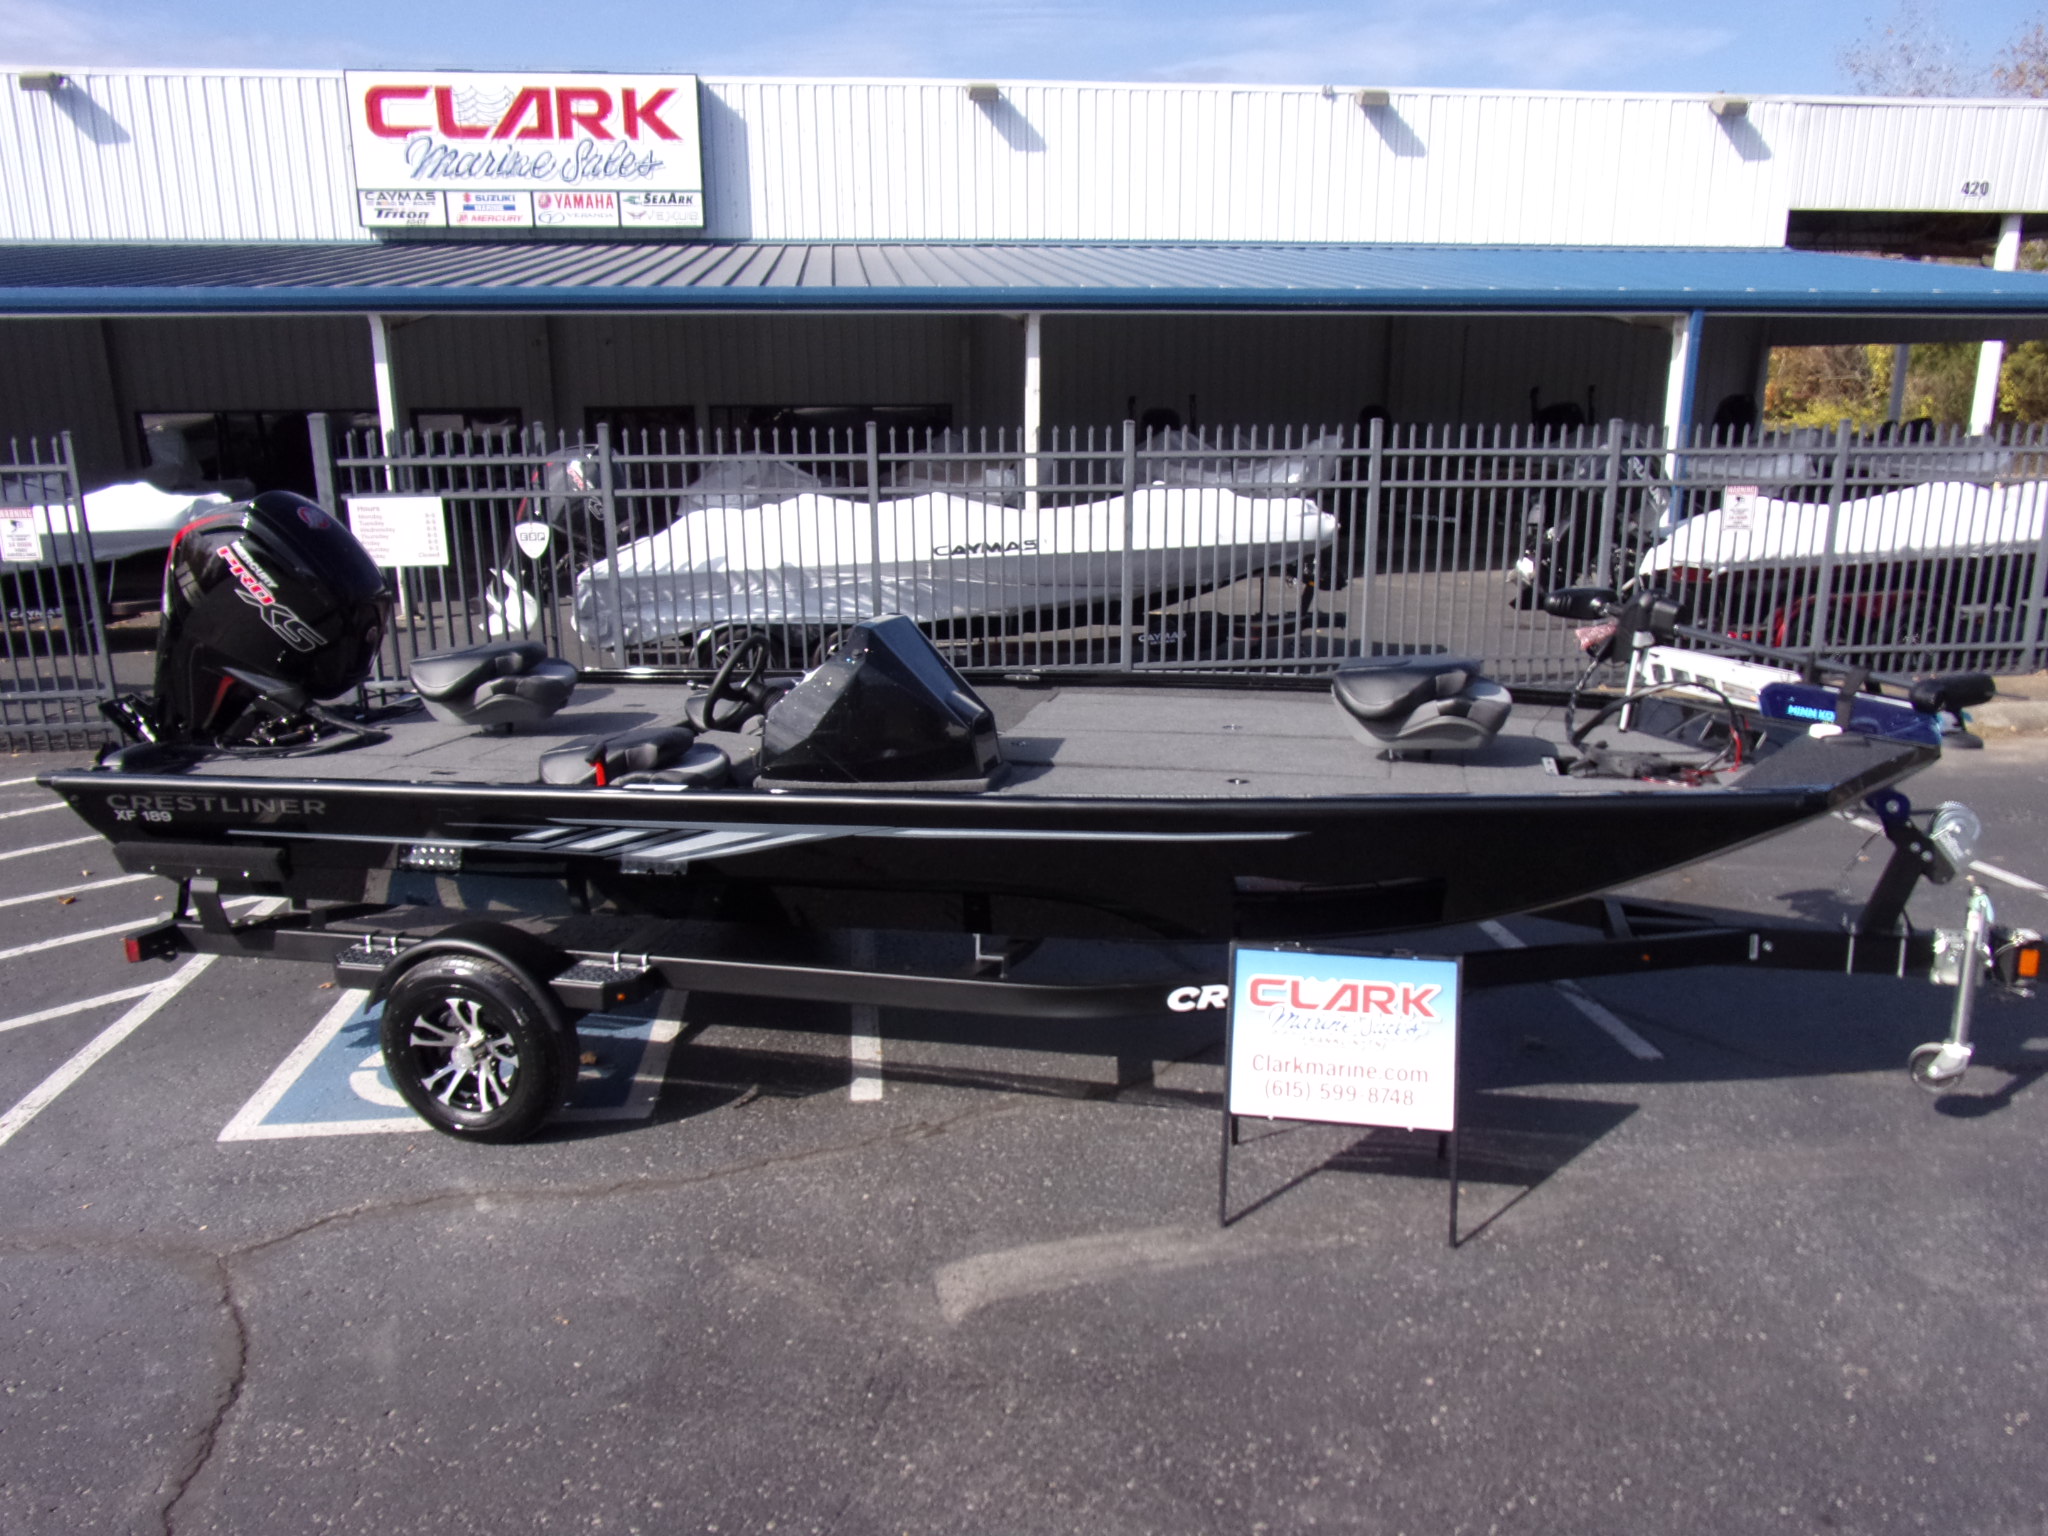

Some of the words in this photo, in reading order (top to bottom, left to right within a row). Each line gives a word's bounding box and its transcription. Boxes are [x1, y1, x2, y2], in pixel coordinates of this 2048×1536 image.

[364, 84, 684, 142] CLARK
[404, 136, 556, 180] Marine
[561, 138, 668, 183] Sales
[364, 191, 436, 201] CAYMAS
[1960, 181, 1989, 196] 420
[475, 194, 516, 203] SUZUKI
[554, 193, 614, 209] YAMAHA
[374, 207, 429, 219] Triton
[471, 214, 523, 223] MERCURY
[933, 538, 1038, 556] CAYMAS
[217, 546, 276, 605] PRO
[234, 589, 328, 652] XS
[1786, 704, 1817, 719] MINN
[106, 794, 326, 816] CRESTLINER
[114, 809, 136, 821] XF
[141, 810, 173, 823] 189
[1250, 978, 1435, 1018] CLARK
[1252, 1053, 1428, 1083] Clarkmarine.com
[1265, 1078, 1311, 1102] (615)
